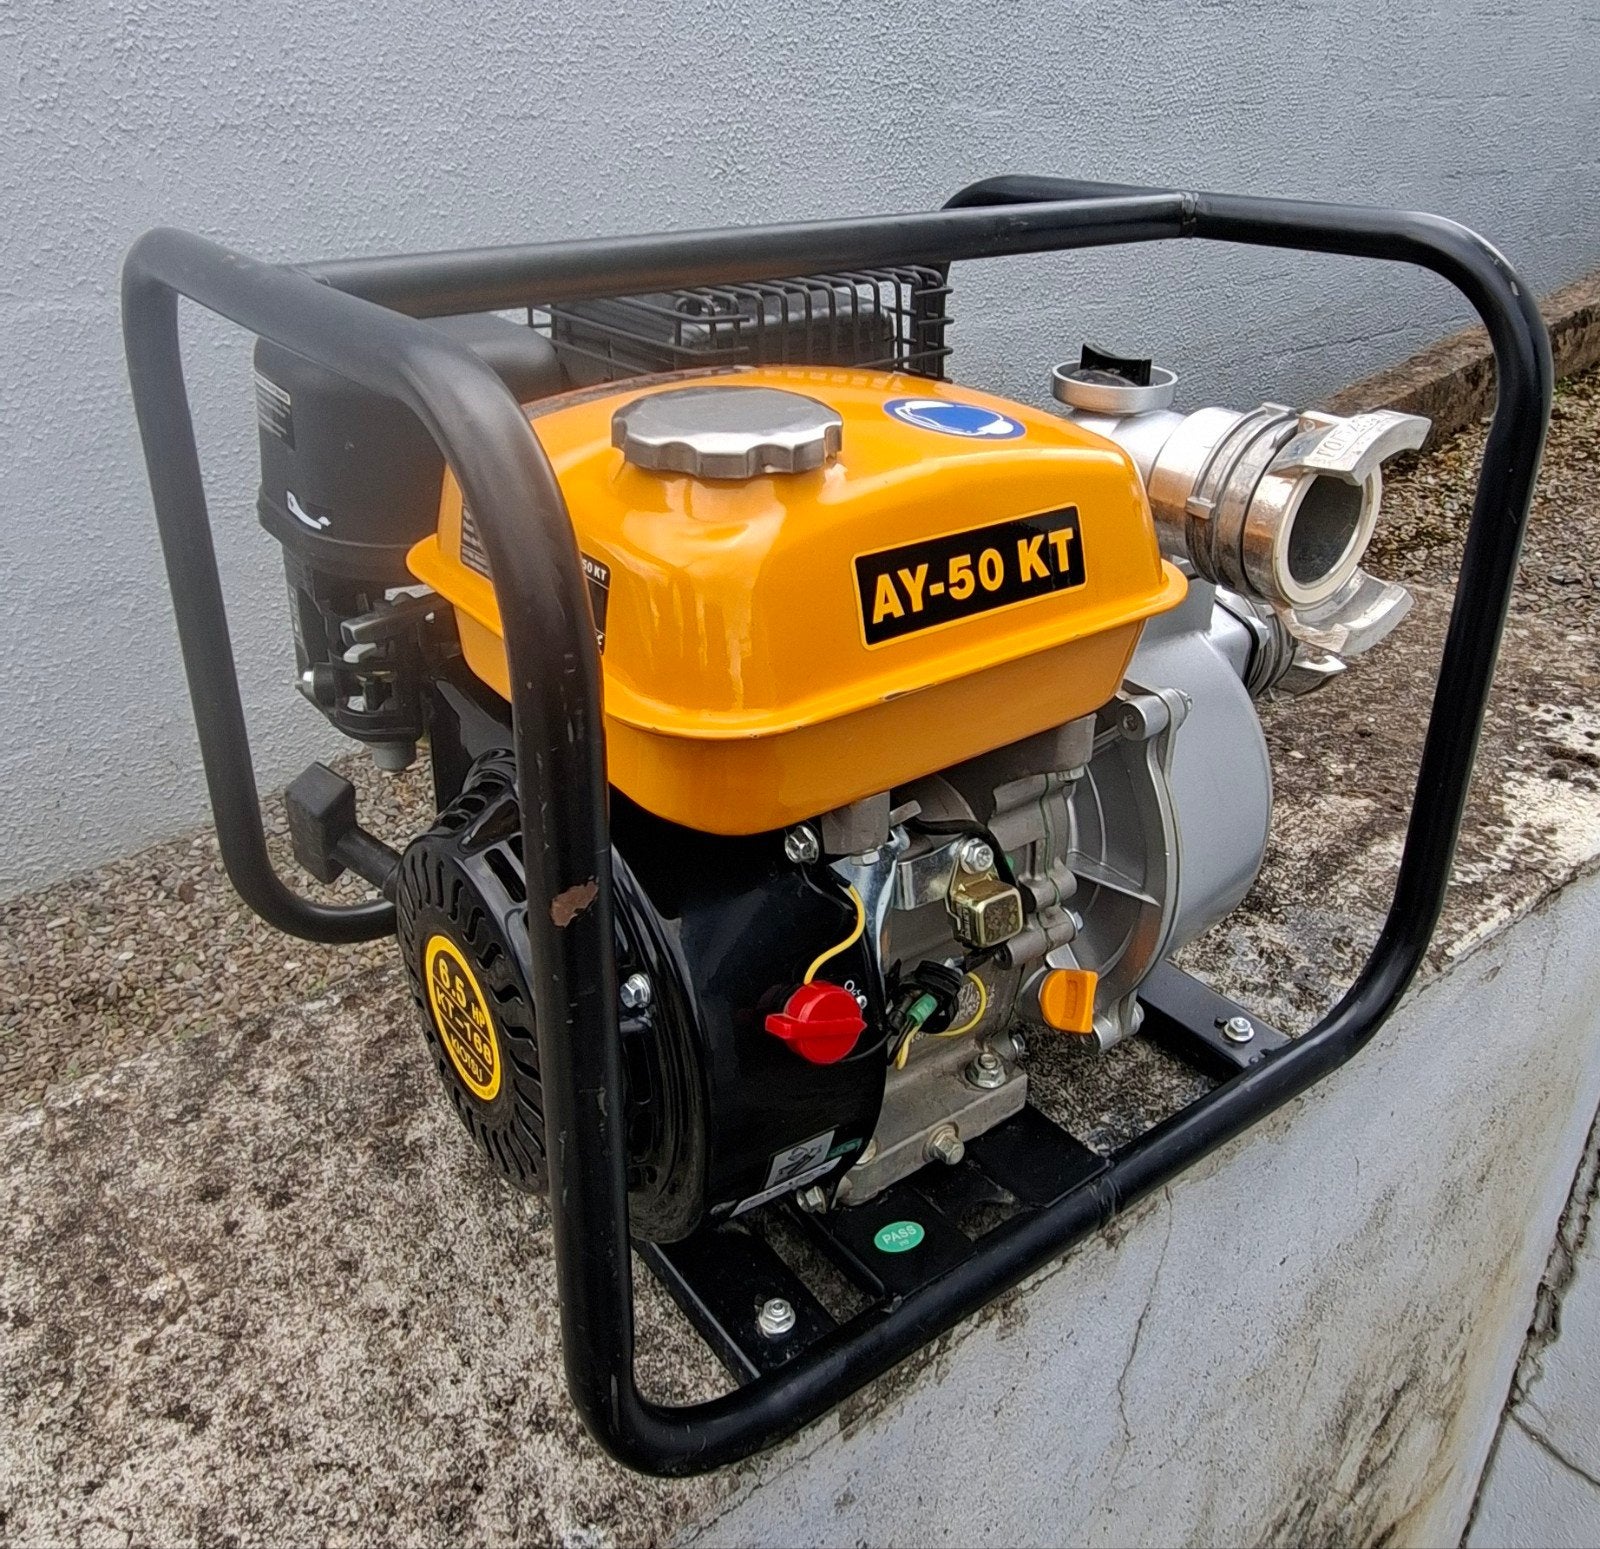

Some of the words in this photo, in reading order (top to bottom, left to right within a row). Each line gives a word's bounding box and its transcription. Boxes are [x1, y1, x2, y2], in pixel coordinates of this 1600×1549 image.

[872, 547, 1005, 625] AY-50
[1016, 526, 1074, 584] KT
[438, 957, 468, 1009] 6.5
[881, 1224, 918, 1246] PASS
